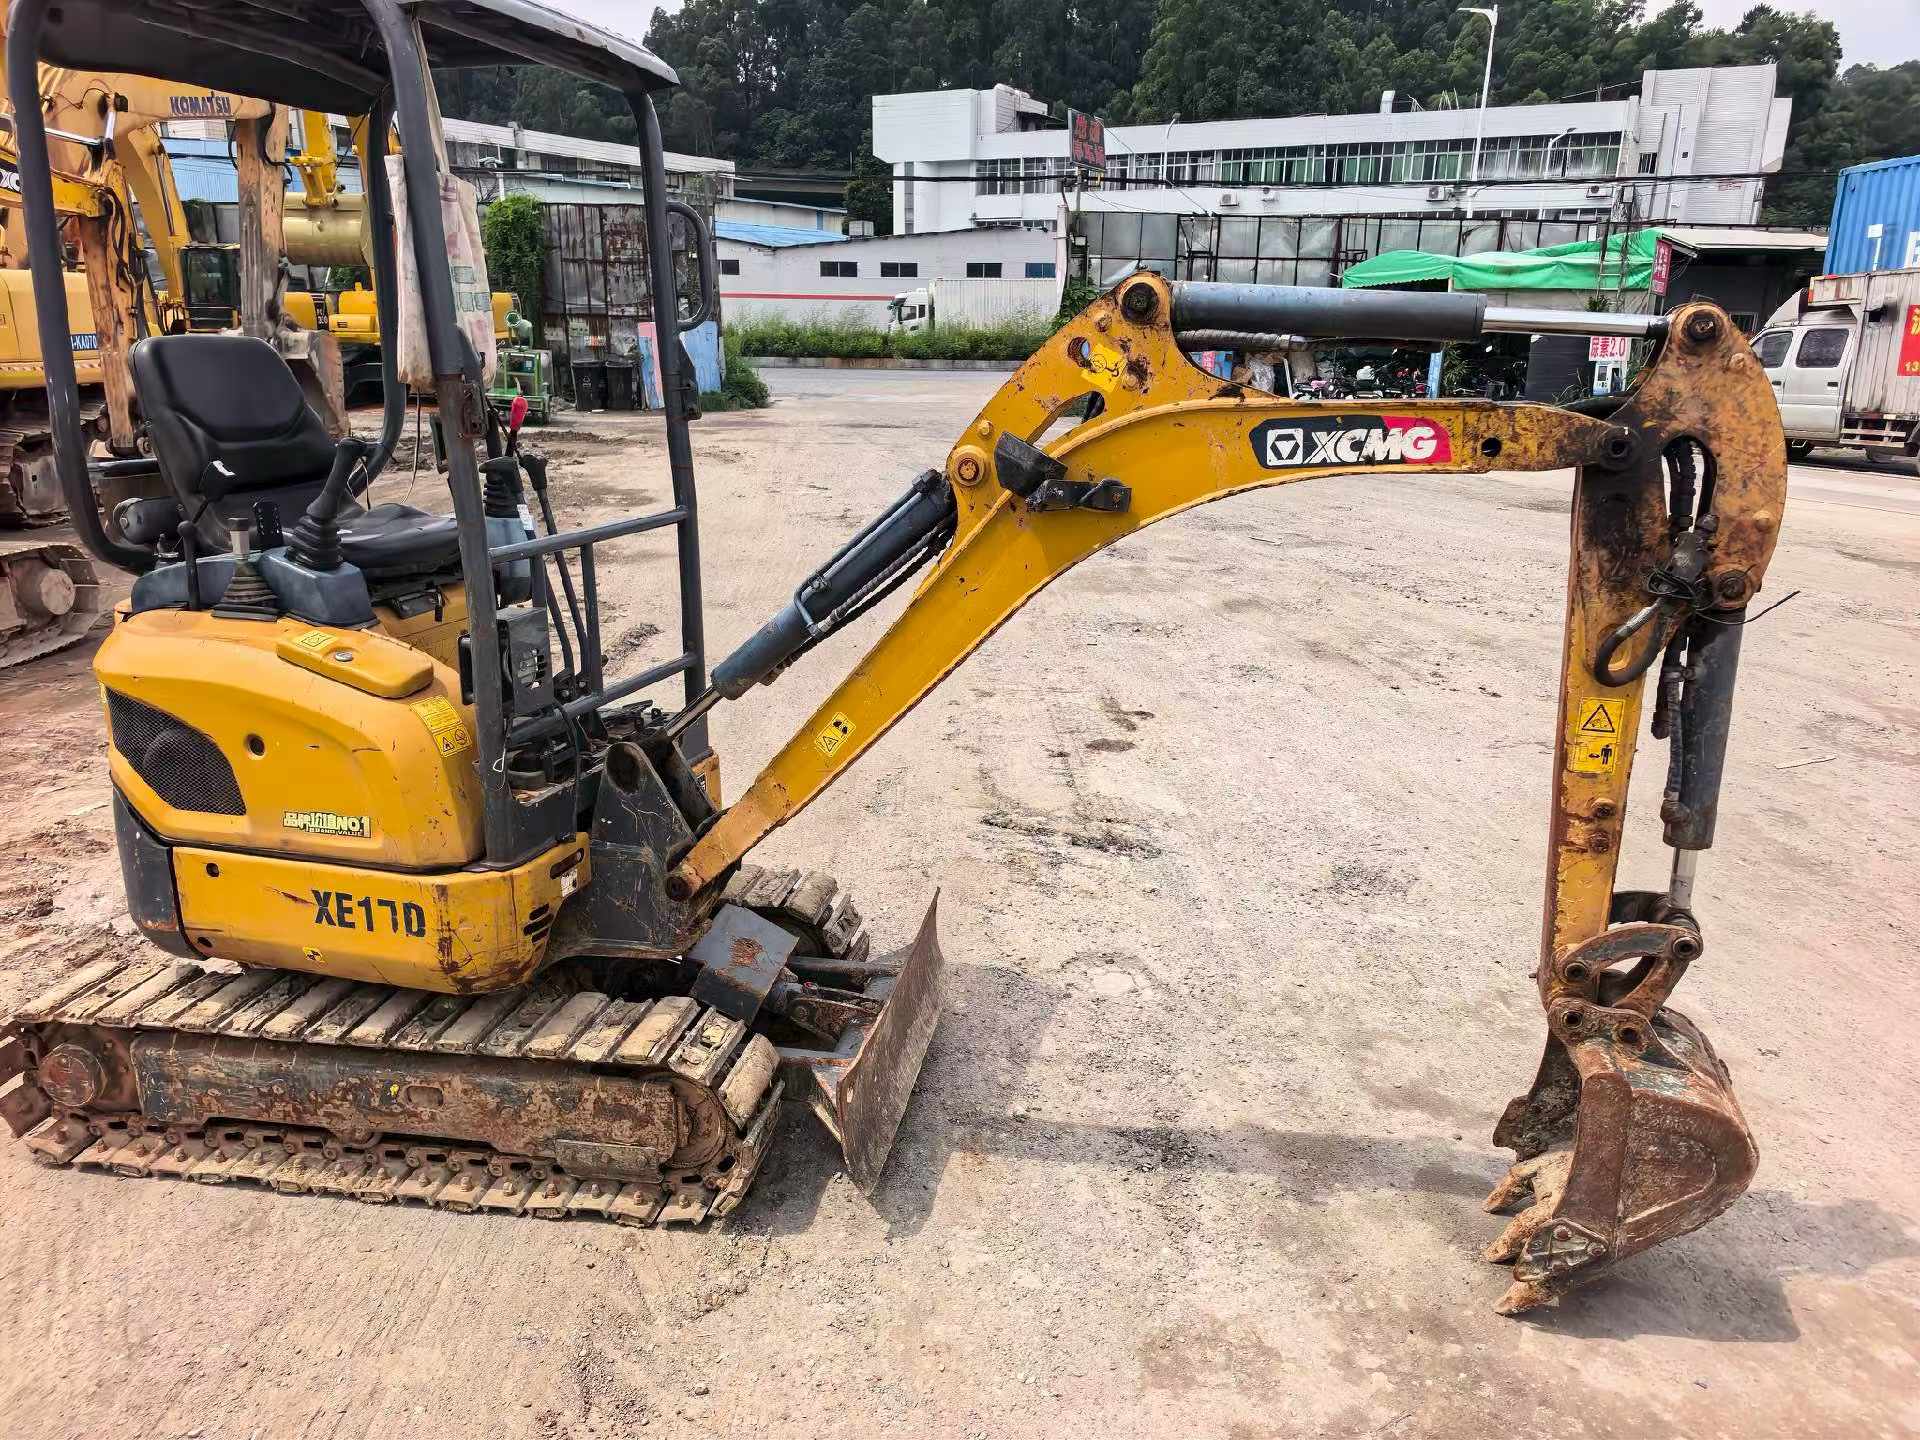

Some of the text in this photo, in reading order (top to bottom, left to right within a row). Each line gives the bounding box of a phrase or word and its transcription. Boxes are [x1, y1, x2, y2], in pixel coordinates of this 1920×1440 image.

[170, 96, 231, 115] KOMATSU
[1591, 337, 1626, 358] 尿素2.0
[1303, 426, 1437, 464] XCMG
[311, 889, 426, 938] XE17D
